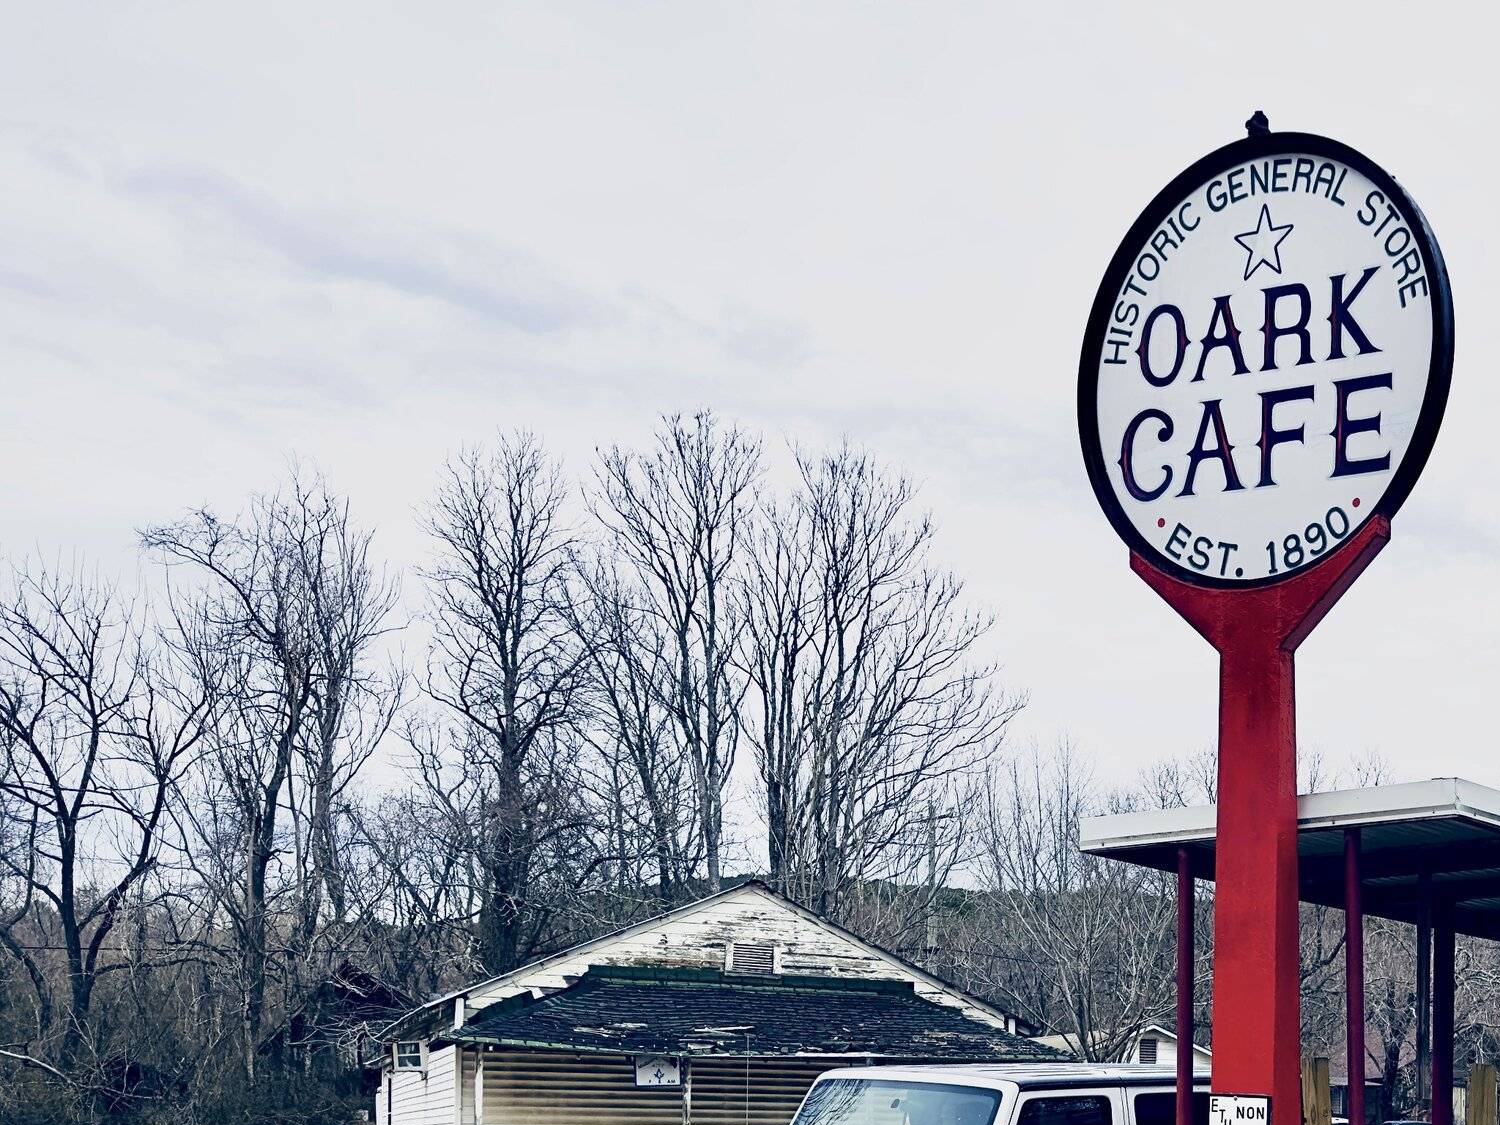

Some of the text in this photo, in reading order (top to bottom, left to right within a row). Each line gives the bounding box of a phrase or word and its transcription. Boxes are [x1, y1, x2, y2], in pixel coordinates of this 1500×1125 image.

[1104, 157, 1429, 365] HISTORIC GENERAL STORE
[1134, 265, 1384, 388] OARK
[1116, 372, 1394, 502] CAFE
[1164, 505, 1351, 578] EST. 1890
[1236, 1106, 1265, 1120] NON
